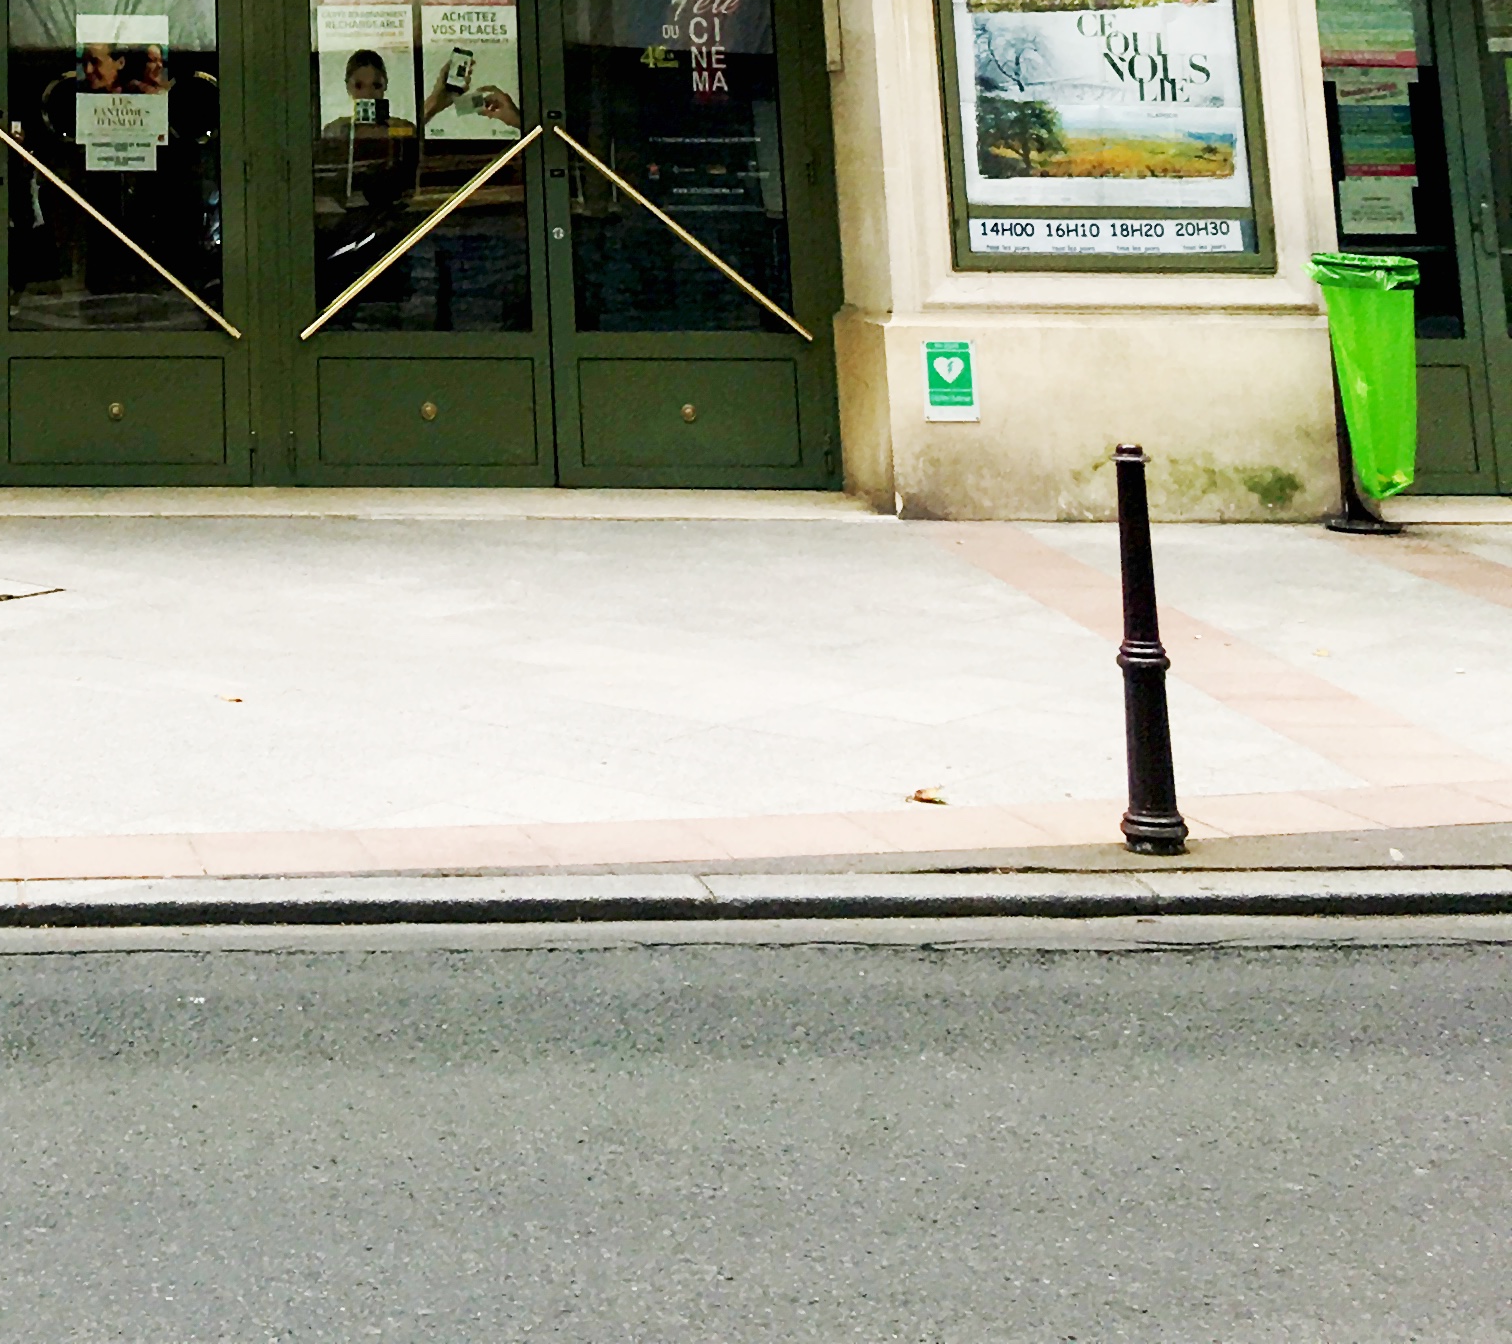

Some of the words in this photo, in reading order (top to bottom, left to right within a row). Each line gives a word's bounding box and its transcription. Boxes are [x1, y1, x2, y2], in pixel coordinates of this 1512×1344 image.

[441, 11, 496, 23] ACHETEZ
[431, 24, 457, 35] VOS
[459, 24, 508, 35] PLACES
[1105, 30, 1162, 62] QUI
[1099, 52, 1210, 84] NOUS
[981, 221, 1035, 237] 14H00
[1046, 222, 1100, 238] 16H10
[1110, 222, 1165, 238] 18H20
[1175, 220, 1230, 237] 20H30
